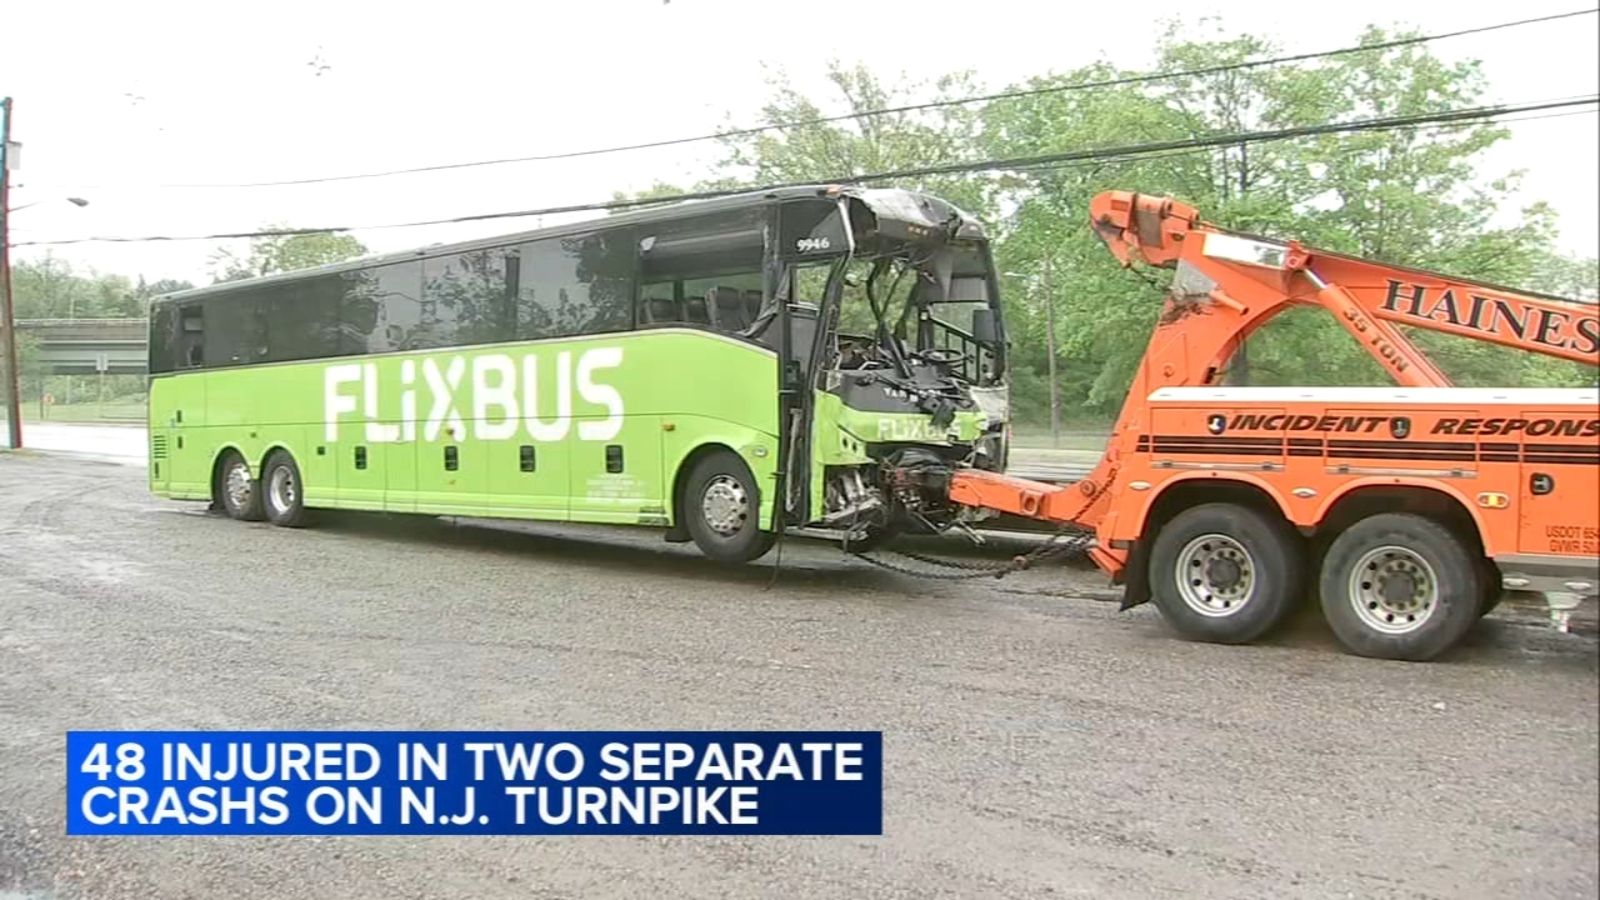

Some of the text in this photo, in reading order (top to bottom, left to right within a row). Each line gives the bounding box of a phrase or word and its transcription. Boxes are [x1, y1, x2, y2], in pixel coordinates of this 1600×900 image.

[796, 237, 830, 251] 9946
[1380, 279, 1599, 354] HAINES
[1343, 307, 1408, 372] 35 TON
[1228, 414, 1599, 438] INCIDENT RESPONS
[1545, 525, 1581, 539] USDOT
